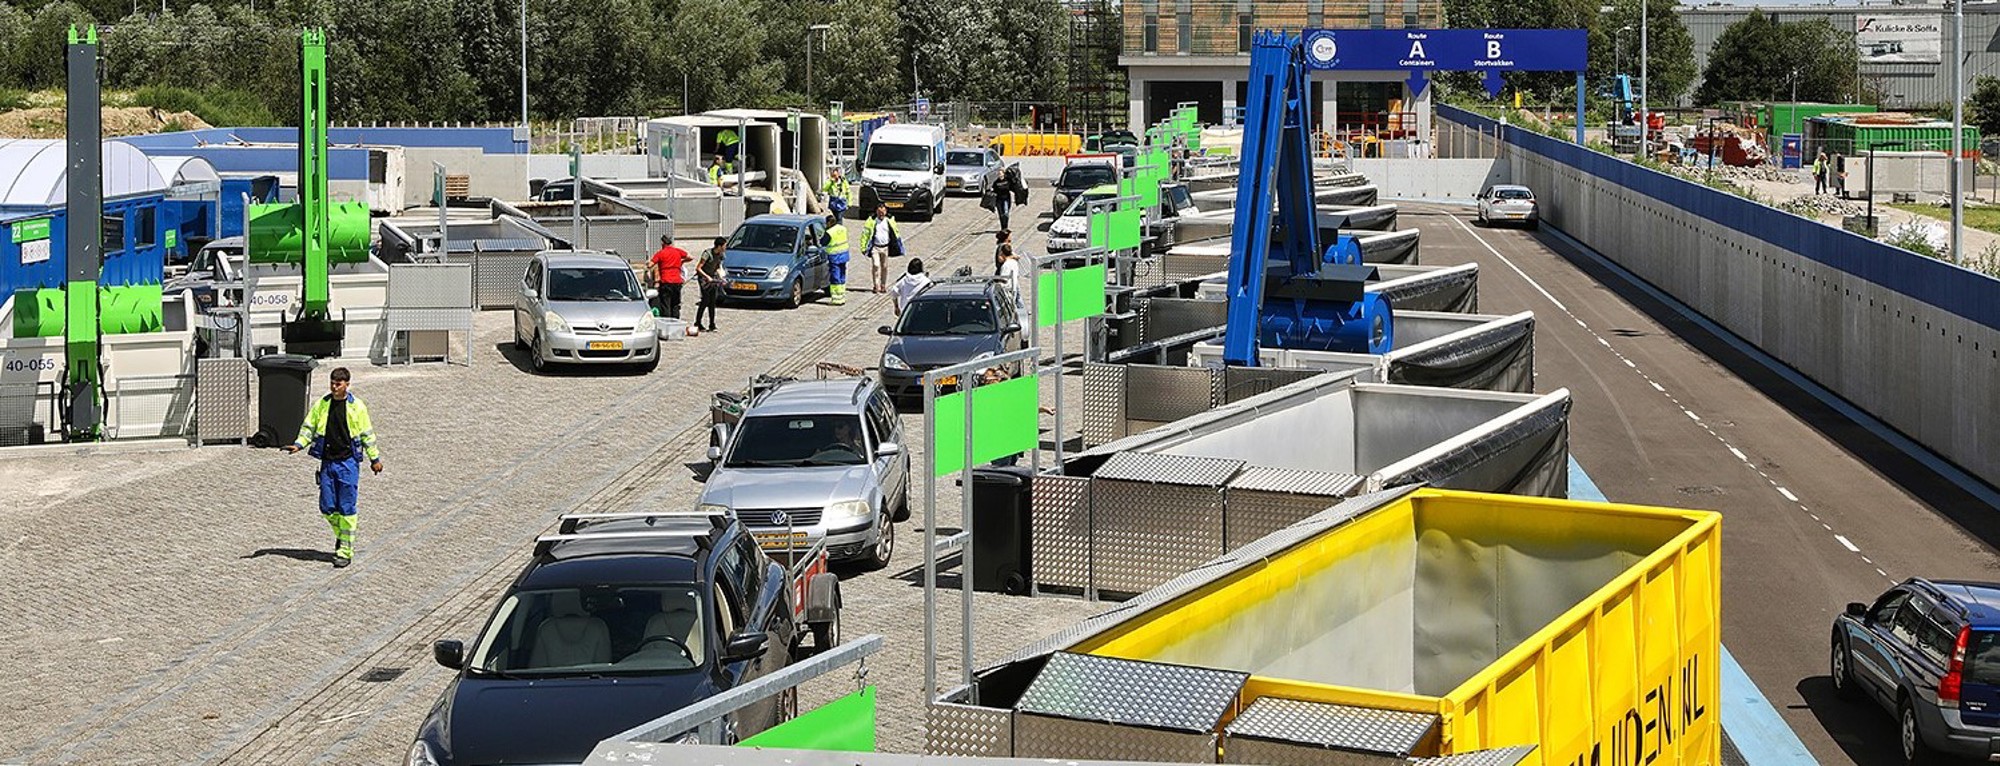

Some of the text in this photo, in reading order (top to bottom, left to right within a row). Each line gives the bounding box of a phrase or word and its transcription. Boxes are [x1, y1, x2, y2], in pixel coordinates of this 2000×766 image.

[1875, 24, 1906, 32] Kulicke
[1409, 40, 1426, 58] A
[1487, 40, 1502, 59] B
[12, 225, 21, 238] 22
[250, 294, 288, 306] 40-058
[6, 358, 55, 372] 40-055
